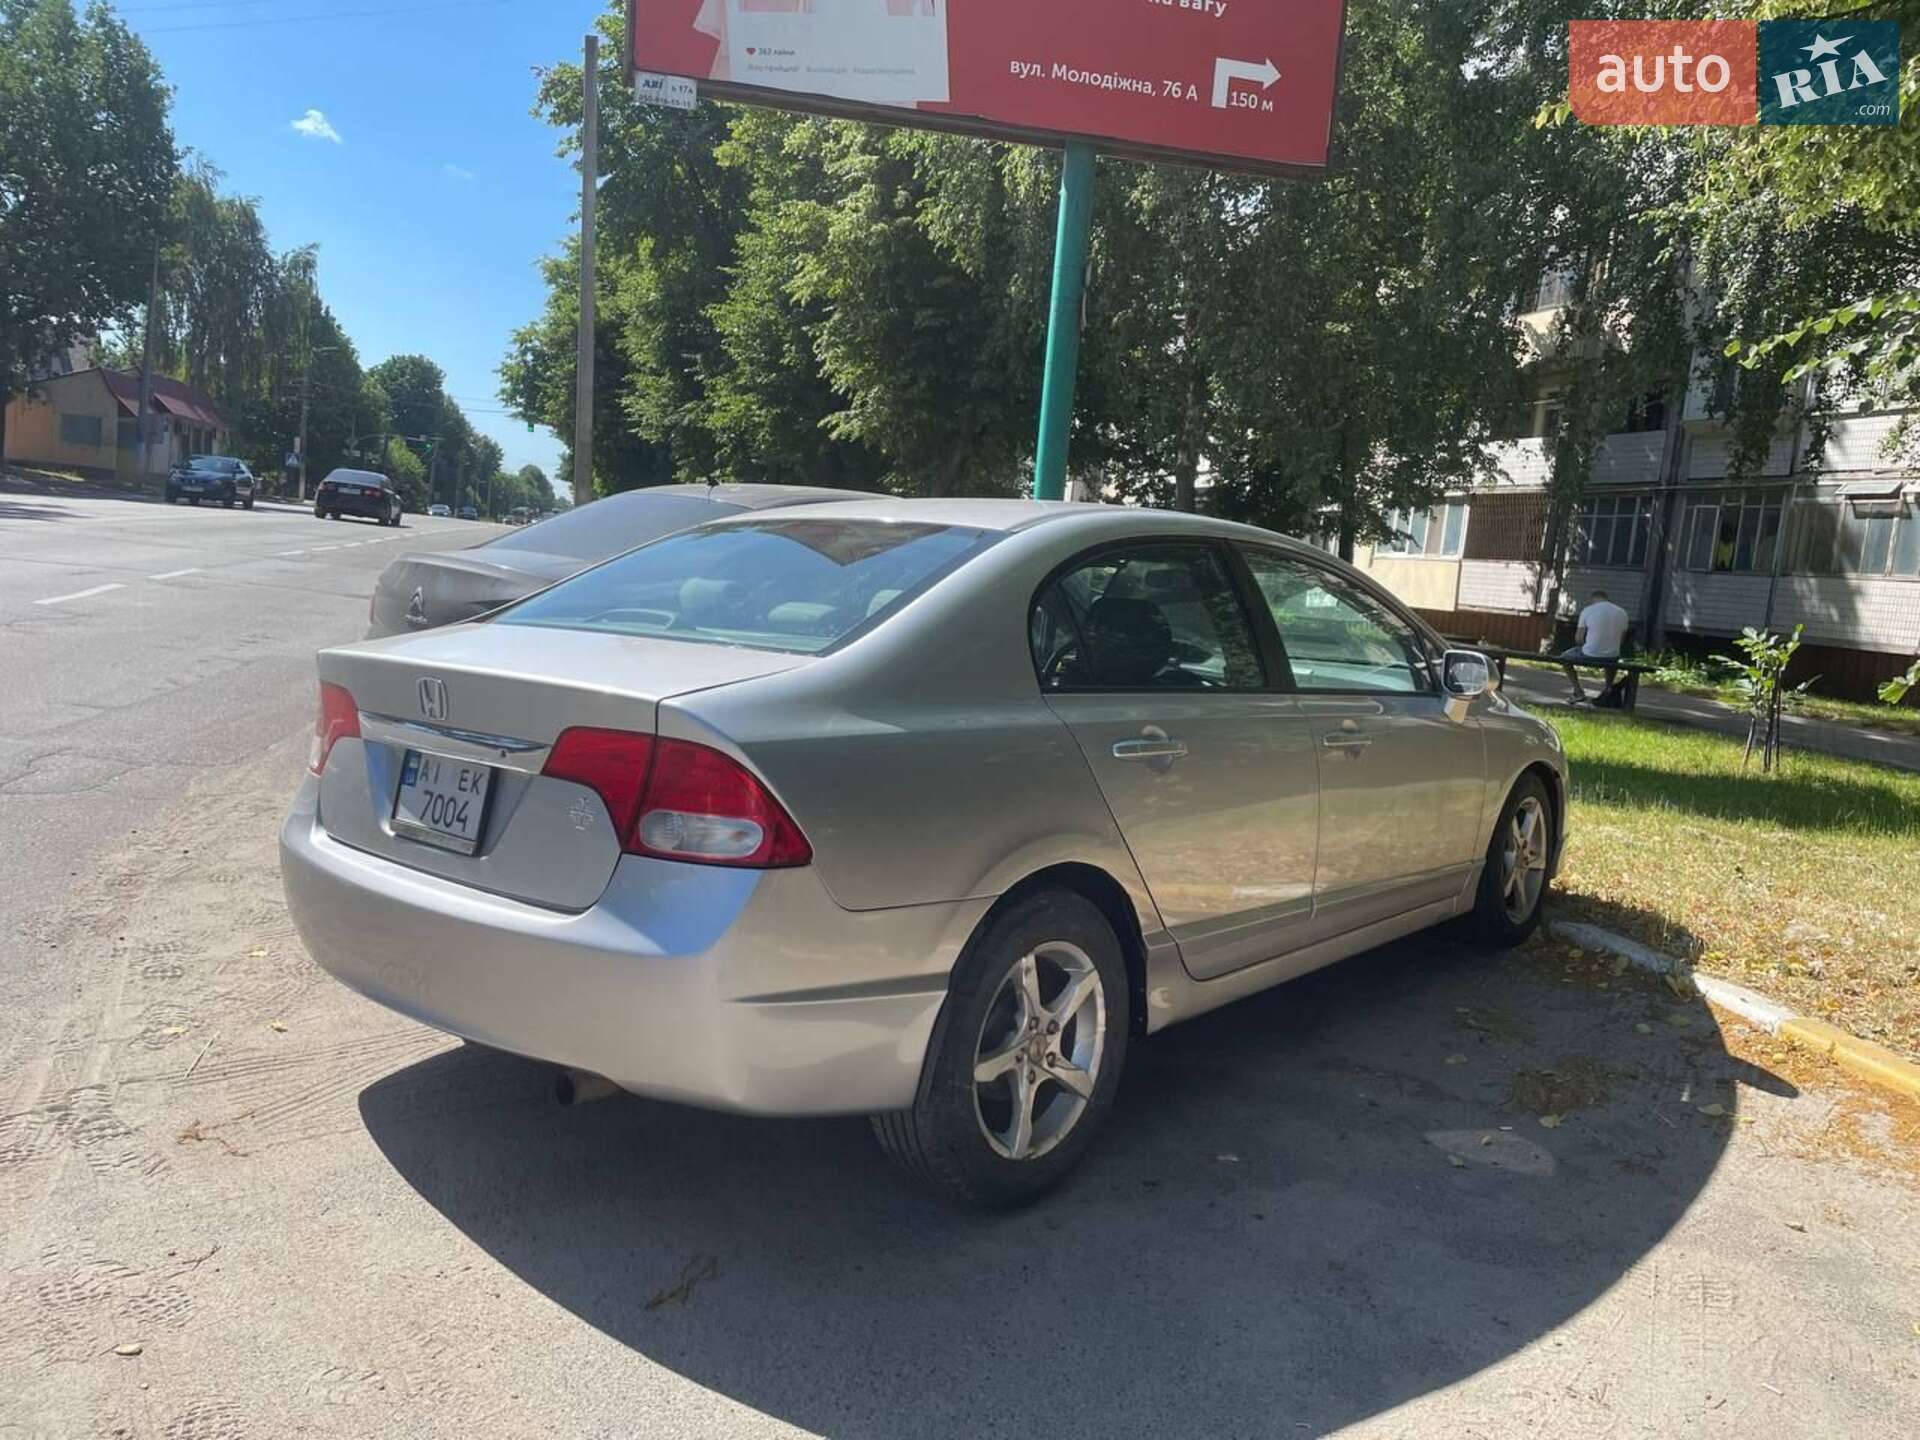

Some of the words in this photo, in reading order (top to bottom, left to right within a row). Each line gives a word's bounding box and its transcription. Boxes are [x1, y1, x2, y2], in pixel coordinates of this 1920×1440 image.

[1010, 60, 1046, 79] вул.
[1051, 63, 1156, 96] Молодіжна,
[1162, 81, 1182, 99] 76
[1185, 84, 1198, 101] А
[1230, 91, 1258, 109] 150
[1261, 99, 1274, 112] м
[419, 759, 441, 784] AI
[458, 768, 484, 796] EK
[419, 789, 470, 833] 7004
